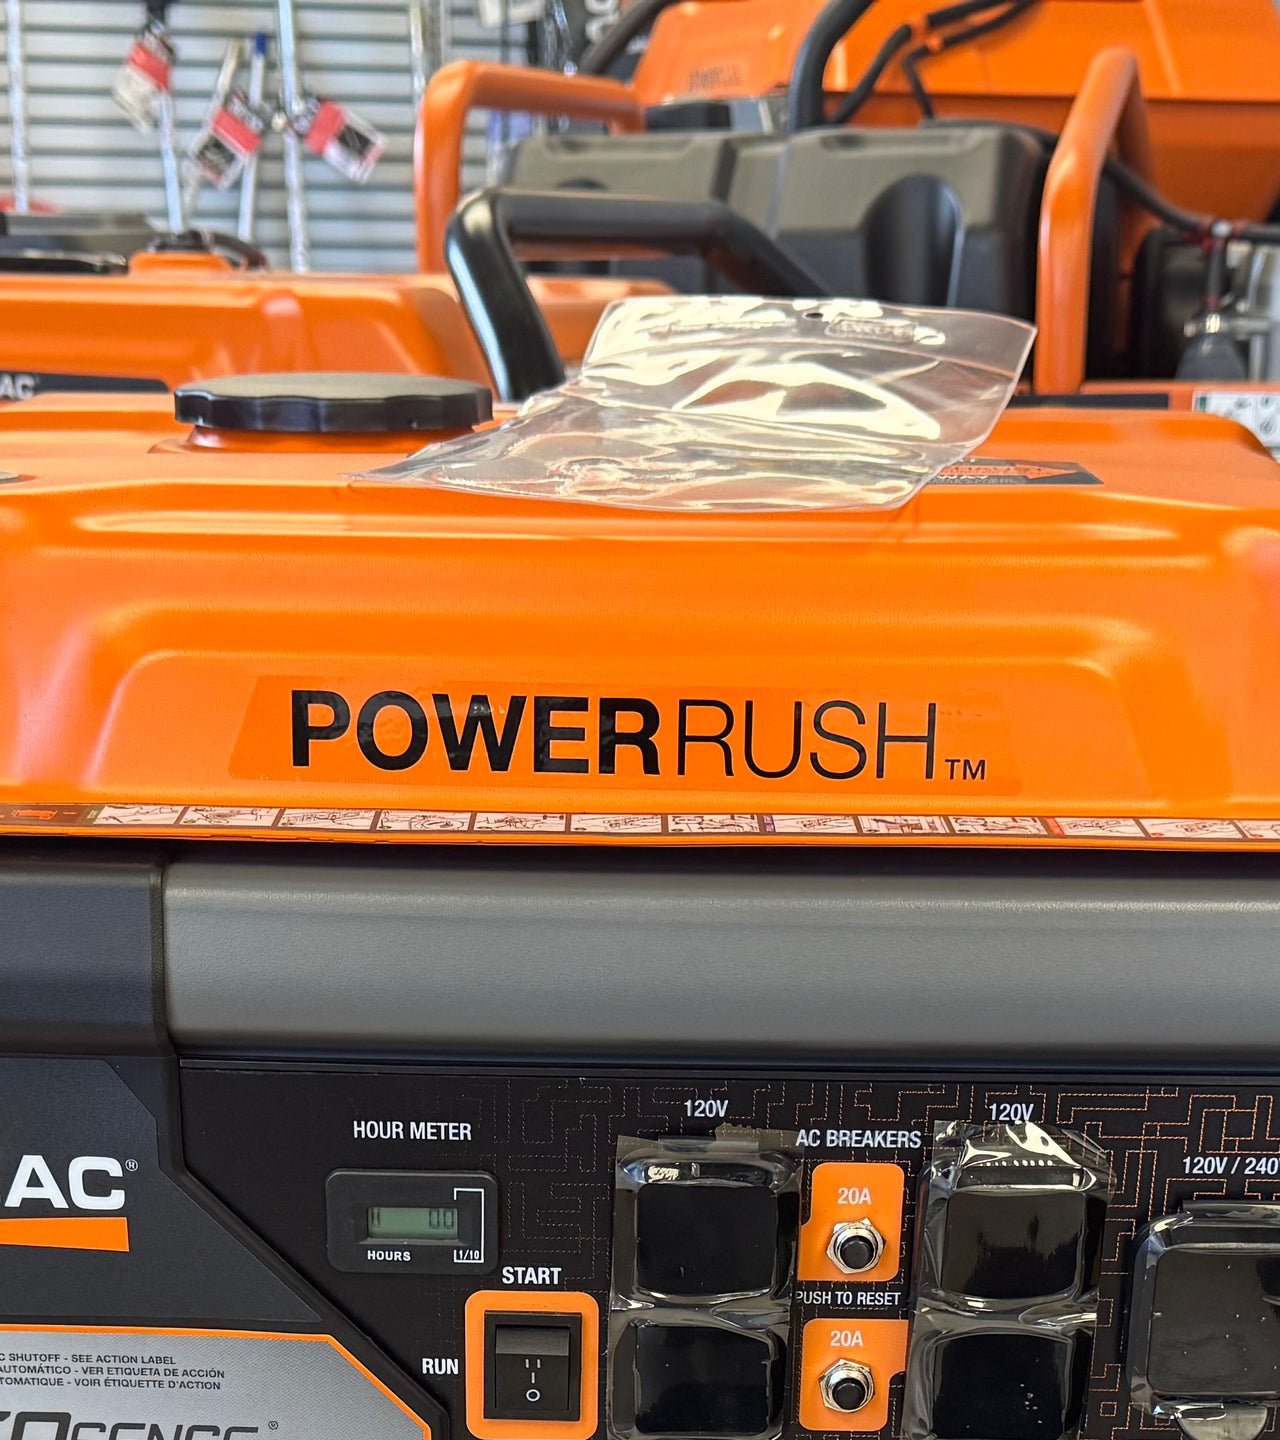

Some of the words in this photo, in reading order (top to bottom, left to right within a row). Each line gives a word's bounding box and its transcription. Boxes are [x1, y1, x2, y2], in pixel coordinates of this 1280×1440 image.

[289, 688, 936, 781] POWERRUSH
[683, 1100, 728, 1118] 120V
[989, 1103, 1035, 1122] 120V
[353, 1120, 404, 1139] HOUR
[410, 1122, 472, 1140] METER
[795, 1129, 821, 1147] AC
[826, 1129, 922, 1149] BREAKERS
[1182, 1155, 1228, 1175] 120V
[837, 1187, 872, 1205] 20A
[367, 1250, 411, 1261] HOURS
[458, 1249, 480, 1260] 1/10
[502, 1267, 562, 1285] START
[795, 1290, 831, 1305] PUSH
[835, 1291, 853, 1305] TO
[857, 1292, 901, 1306] RESET
[830, 1330, 864, 1347] 20A
[8, 1353, 61, 1363] SHUTOFF
[71, 1354, 93, 1363] SEE
[96, 1355, 138, 1364] ACTION
[141, 1355, 176, 1365] LABEL
[422, 1358, 459, 1375] RUN
[81, 1366, 104, 1375] VER
[107, 1366, 161, 1377] ETIQUETA
[163, 1368, 179, 1377] DE
[181, 1366, 225, 1379] ACCIÓN
[74, 1377, 101, 1387] VOIR
[104, 1376, 165, 1389] ÉTIQUETTE
[168, 1379, 220, 1390] D'ACTION
